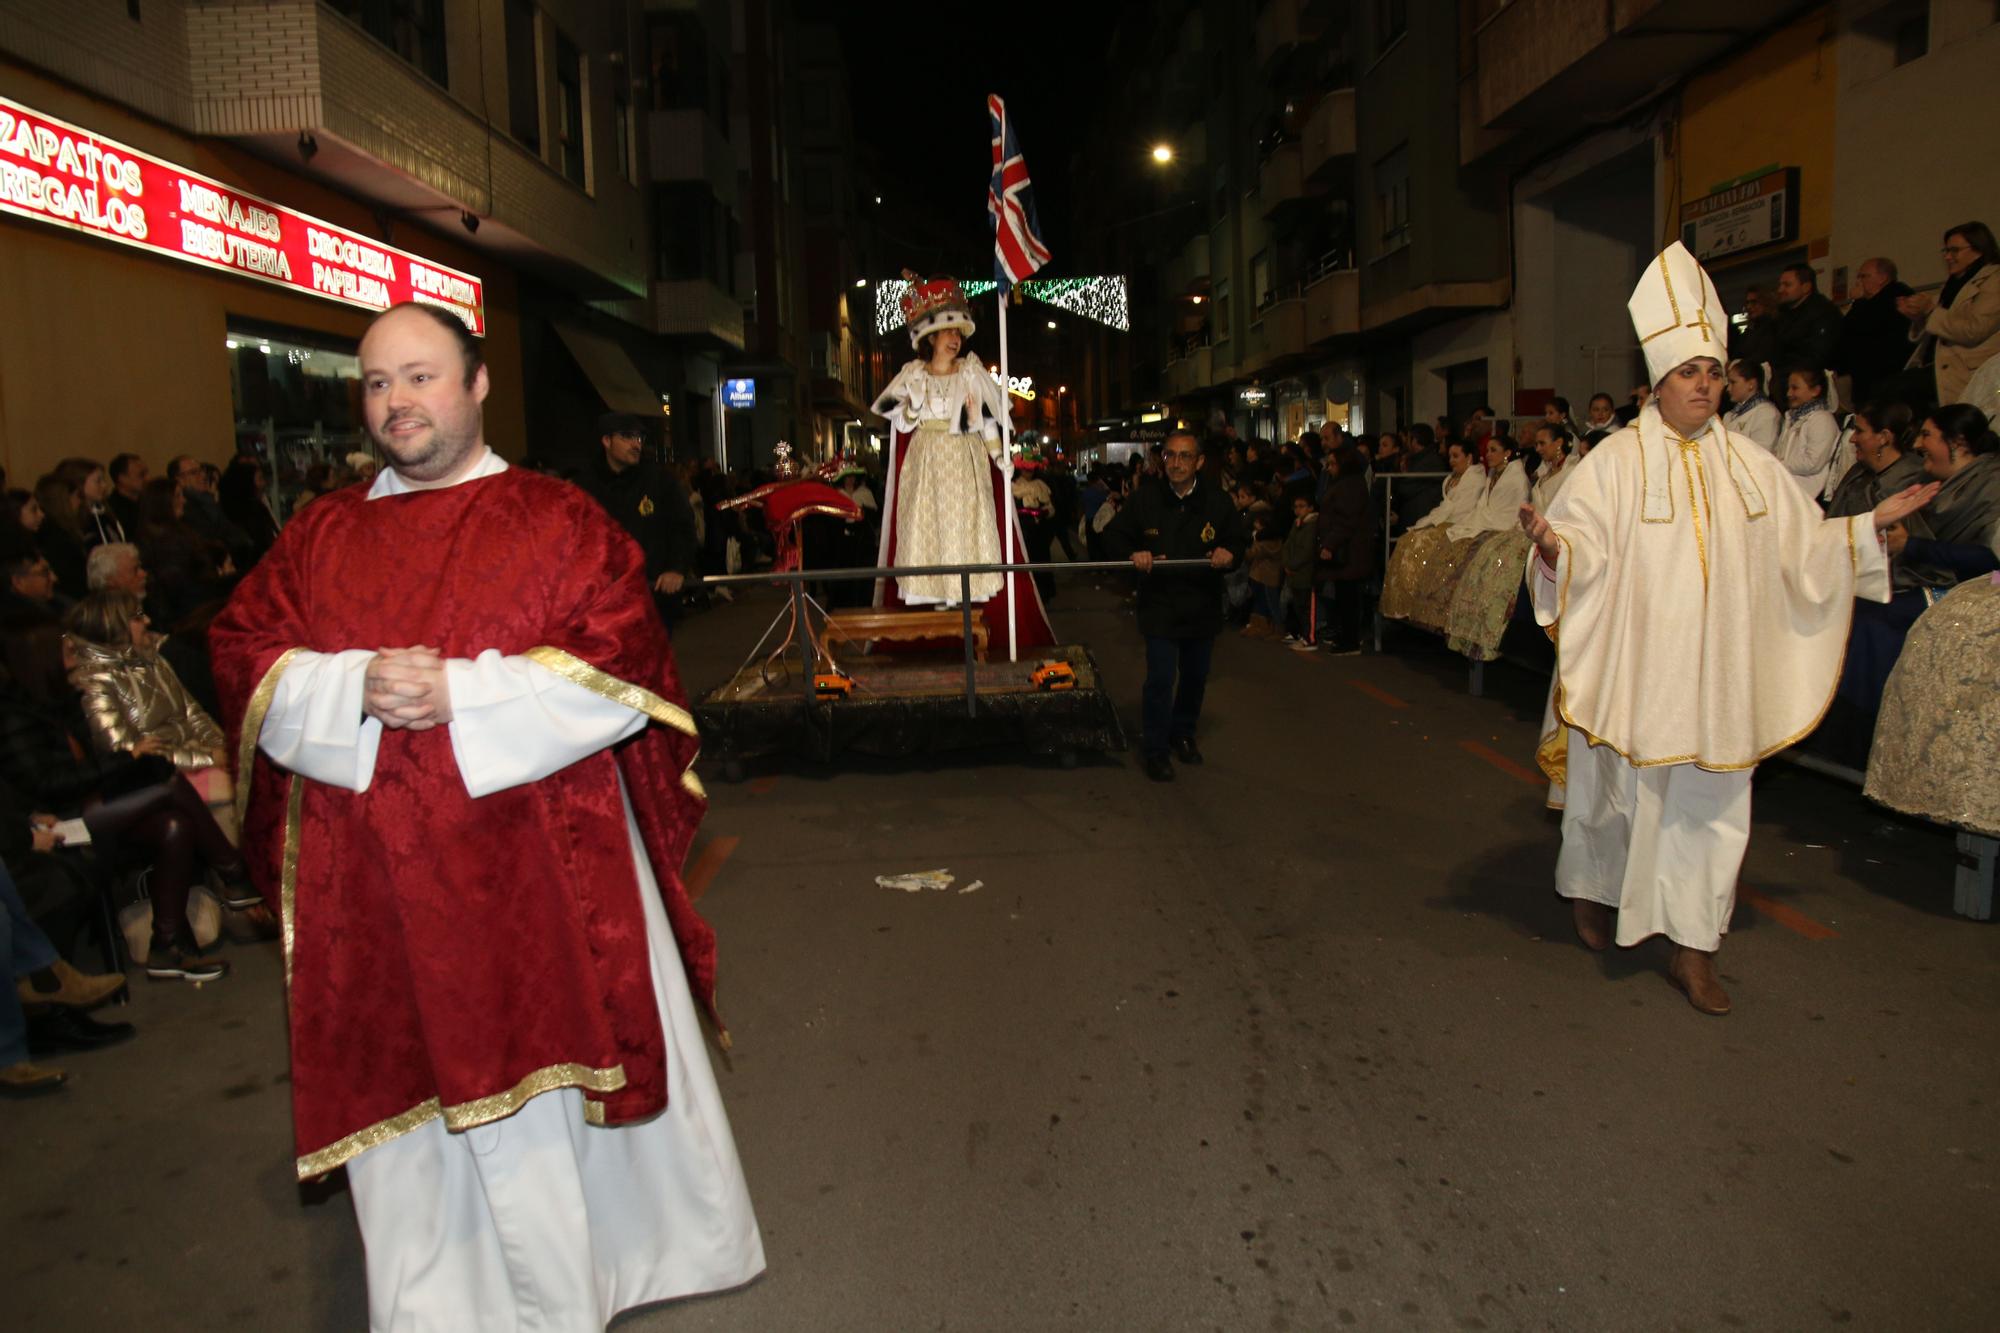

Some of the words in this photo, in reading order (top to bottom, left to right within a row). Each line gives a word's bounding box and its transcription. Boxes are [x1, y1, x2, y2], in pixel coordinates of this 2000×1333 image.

[0, 111, 142, 197] ZAPATOS
[0, 159, 148, 240] REGALOS
[178, 179, 281, 243] MENAJES
[181, 219, 292, 281] BISUTERIA
[307, 227, 396, 281] DROGUERIA
[312, 262, 391, 308] PAPELERIA
[410, 263, 477, 306] PERFUMERIA
